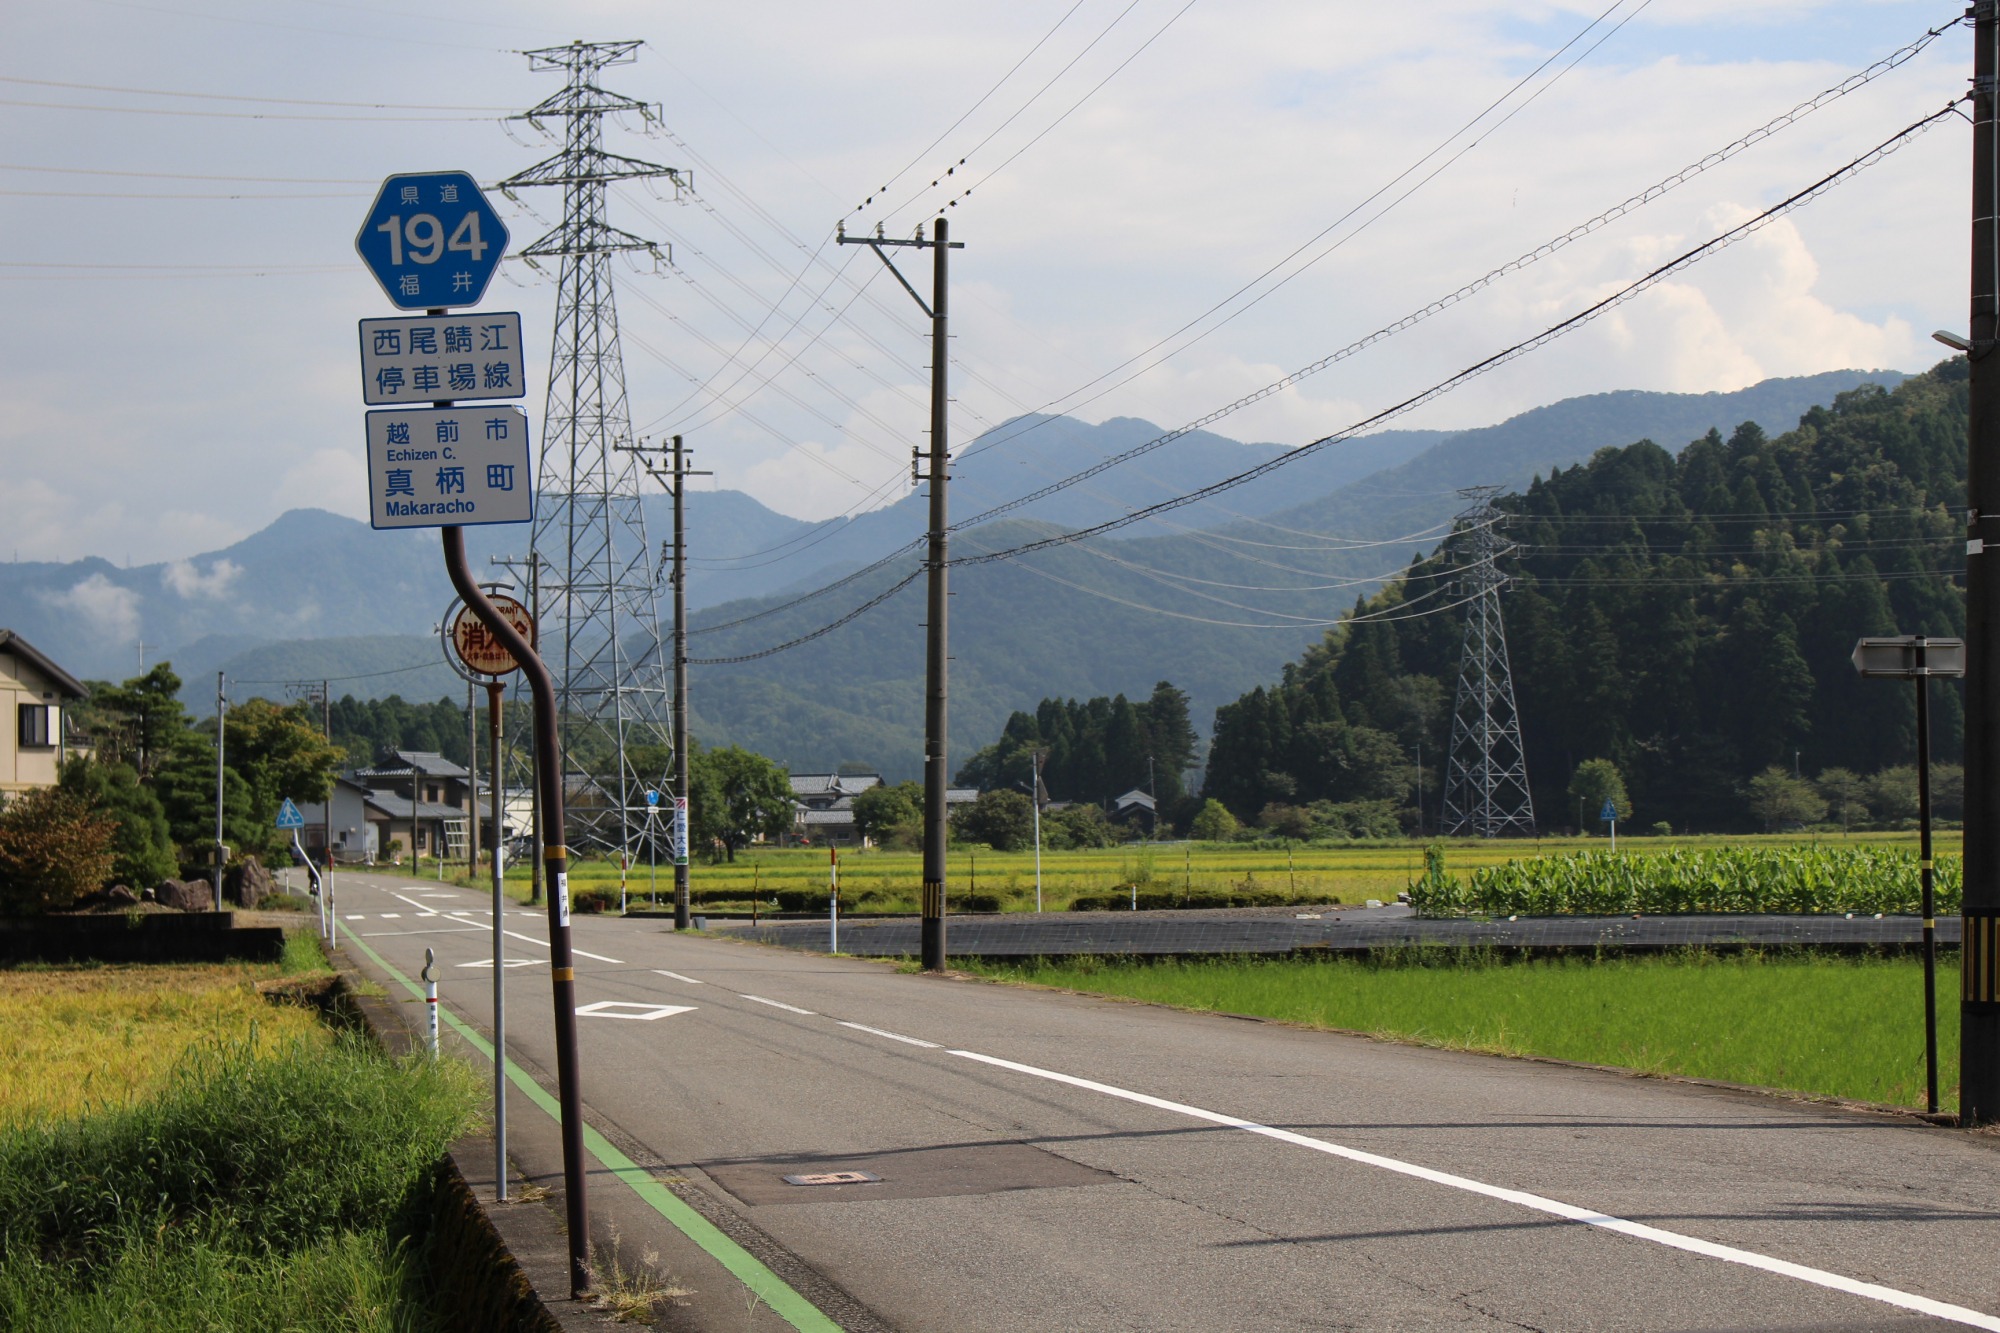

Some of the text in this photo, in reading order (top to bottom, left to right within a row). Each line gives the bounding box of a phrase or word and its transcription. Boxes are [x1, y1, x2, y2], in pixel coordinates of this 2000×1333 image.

[401, 184, 459, 205] 県道
[377, 211, 488, 266] 194
[399, 271, 473, 296] 福井
[372, 324, 508, 356] 西尾鯖江
[375, 361, 512, 395] 停車場線
[386, 418, 508, 445] 越前市
[387, 447, 457, 462] Echizen C.
[385, 464, 514, 497] 真柄町
[386, 499, 475, 517] Makaracho
[676, 811, 687, 857] 仁愛大学
